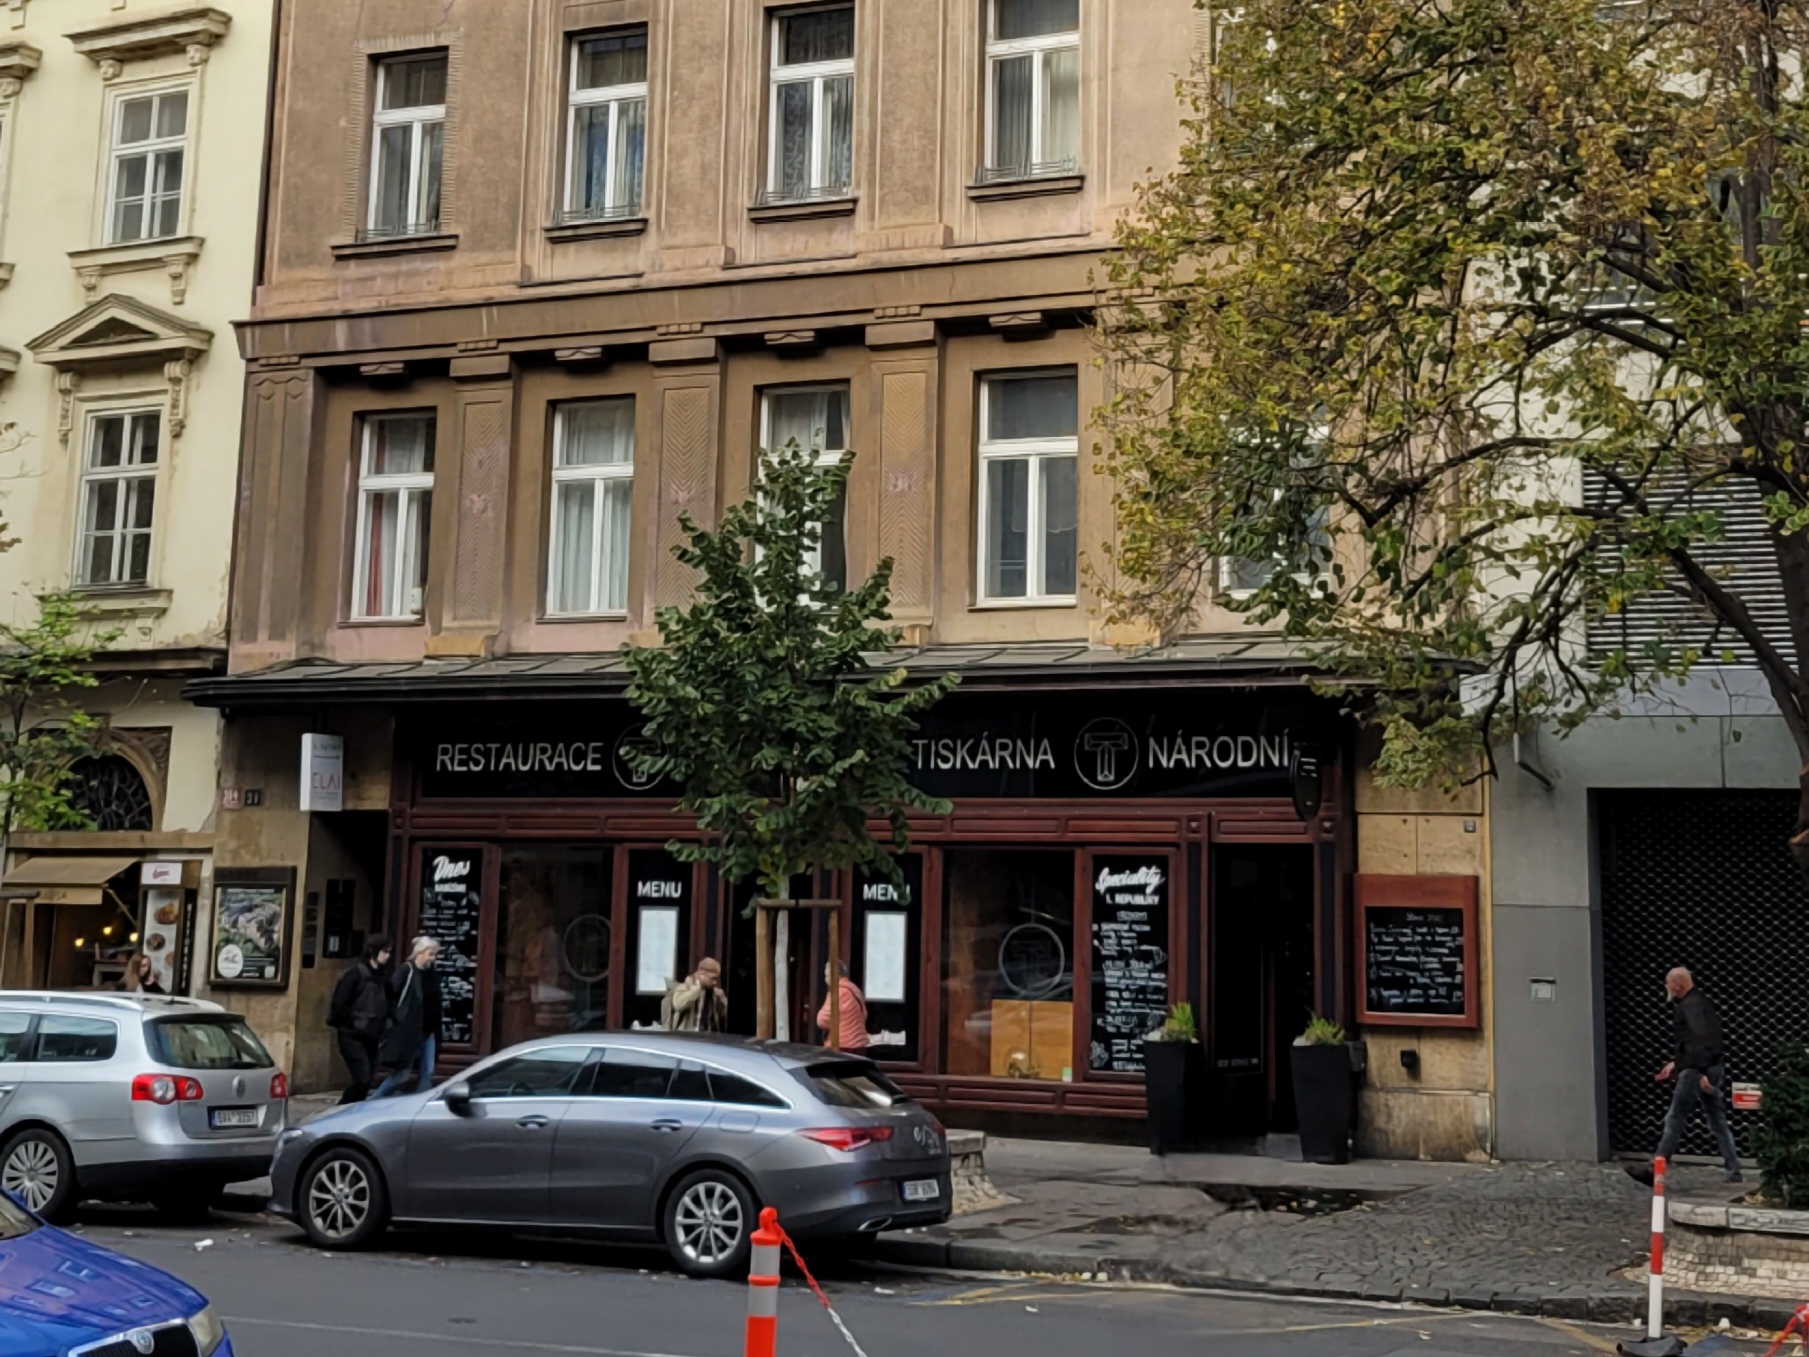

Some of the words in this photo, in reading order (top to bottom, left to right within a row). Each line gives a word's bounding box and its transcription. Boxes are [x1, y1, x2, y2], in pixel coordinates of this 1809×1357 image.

[436, 742, 603, 772] RESTAURACE
[912, 731, 1055, 769] TISKÁRNA
[1149, 729, 1289, 768] NÁRODNÍ
[432, 855, 470, 882] Dnes
[637, 880, 682, 898] MENU
[863, 884, 910, 901] MEN
